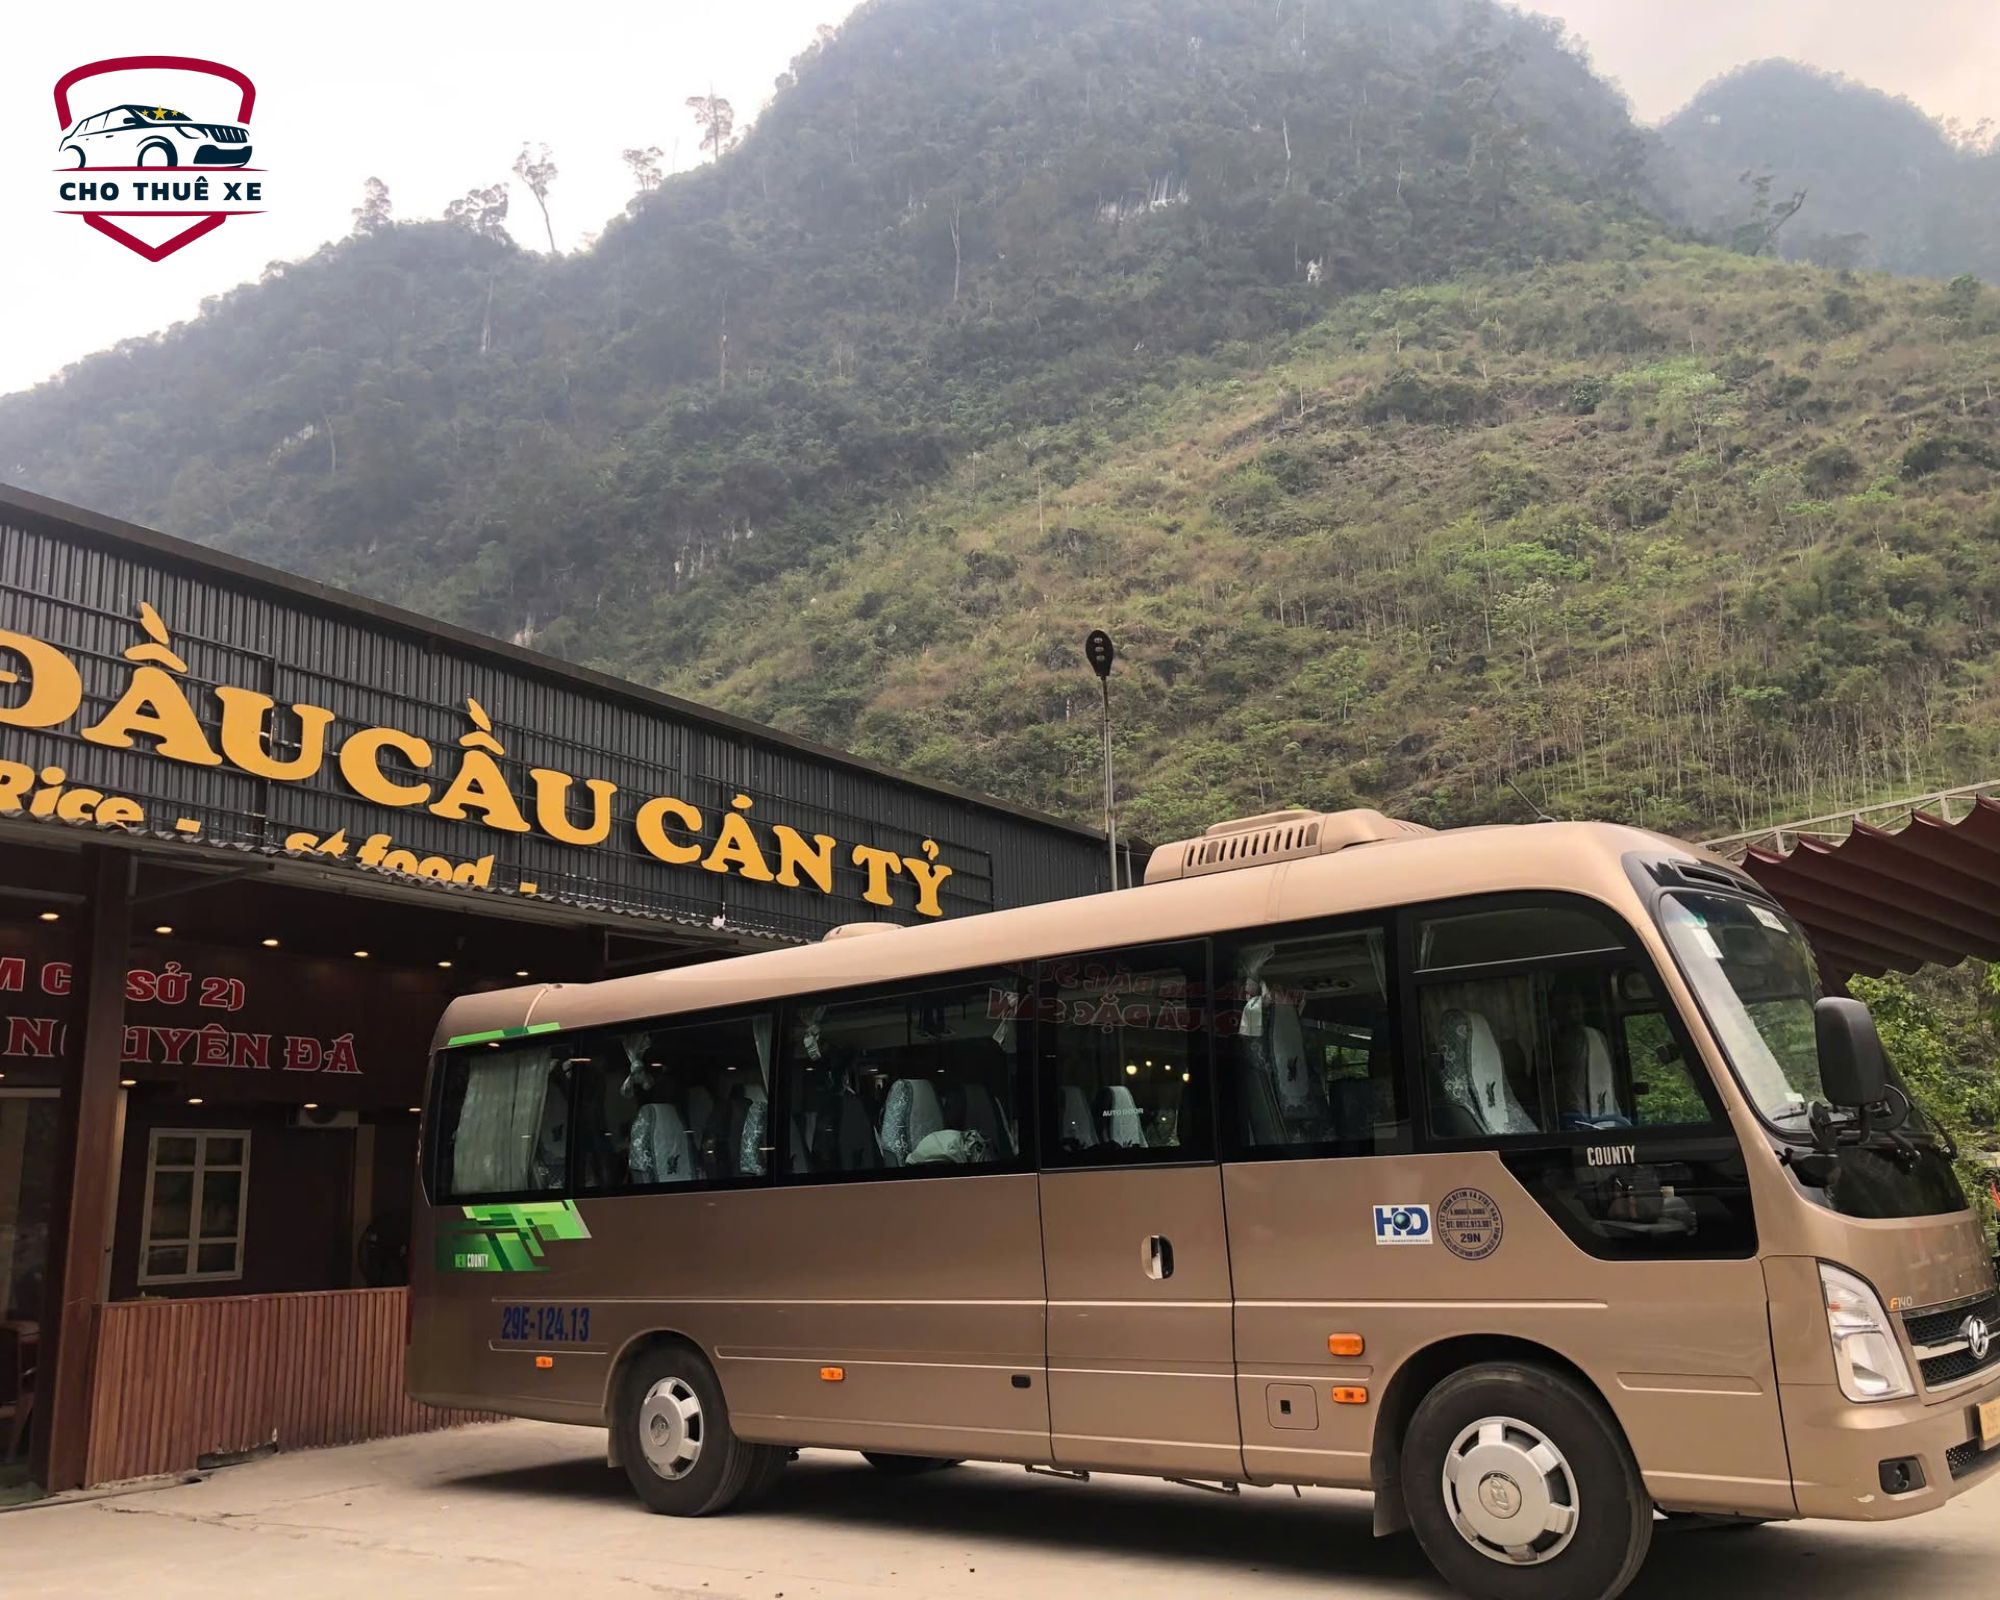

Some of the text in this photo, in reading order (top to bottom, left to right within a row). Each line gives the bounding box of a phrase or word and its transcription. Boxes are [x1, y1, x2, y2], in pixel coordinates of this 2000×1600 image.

[340, 698, 617, 845] CẦU
[852, 839, 953, 917] TỶ
[126, 961, 192, 1004] SỞ
[200, 977, 245, 1011] 2)
[283, 1032, 363, 1075] ĐÁ
[1587, 1144, 1637, 1167] COUNTY
[1460, 1233, 1482, 1244] 29N
[502, 1306, 590, 1342] 29E-124.13
